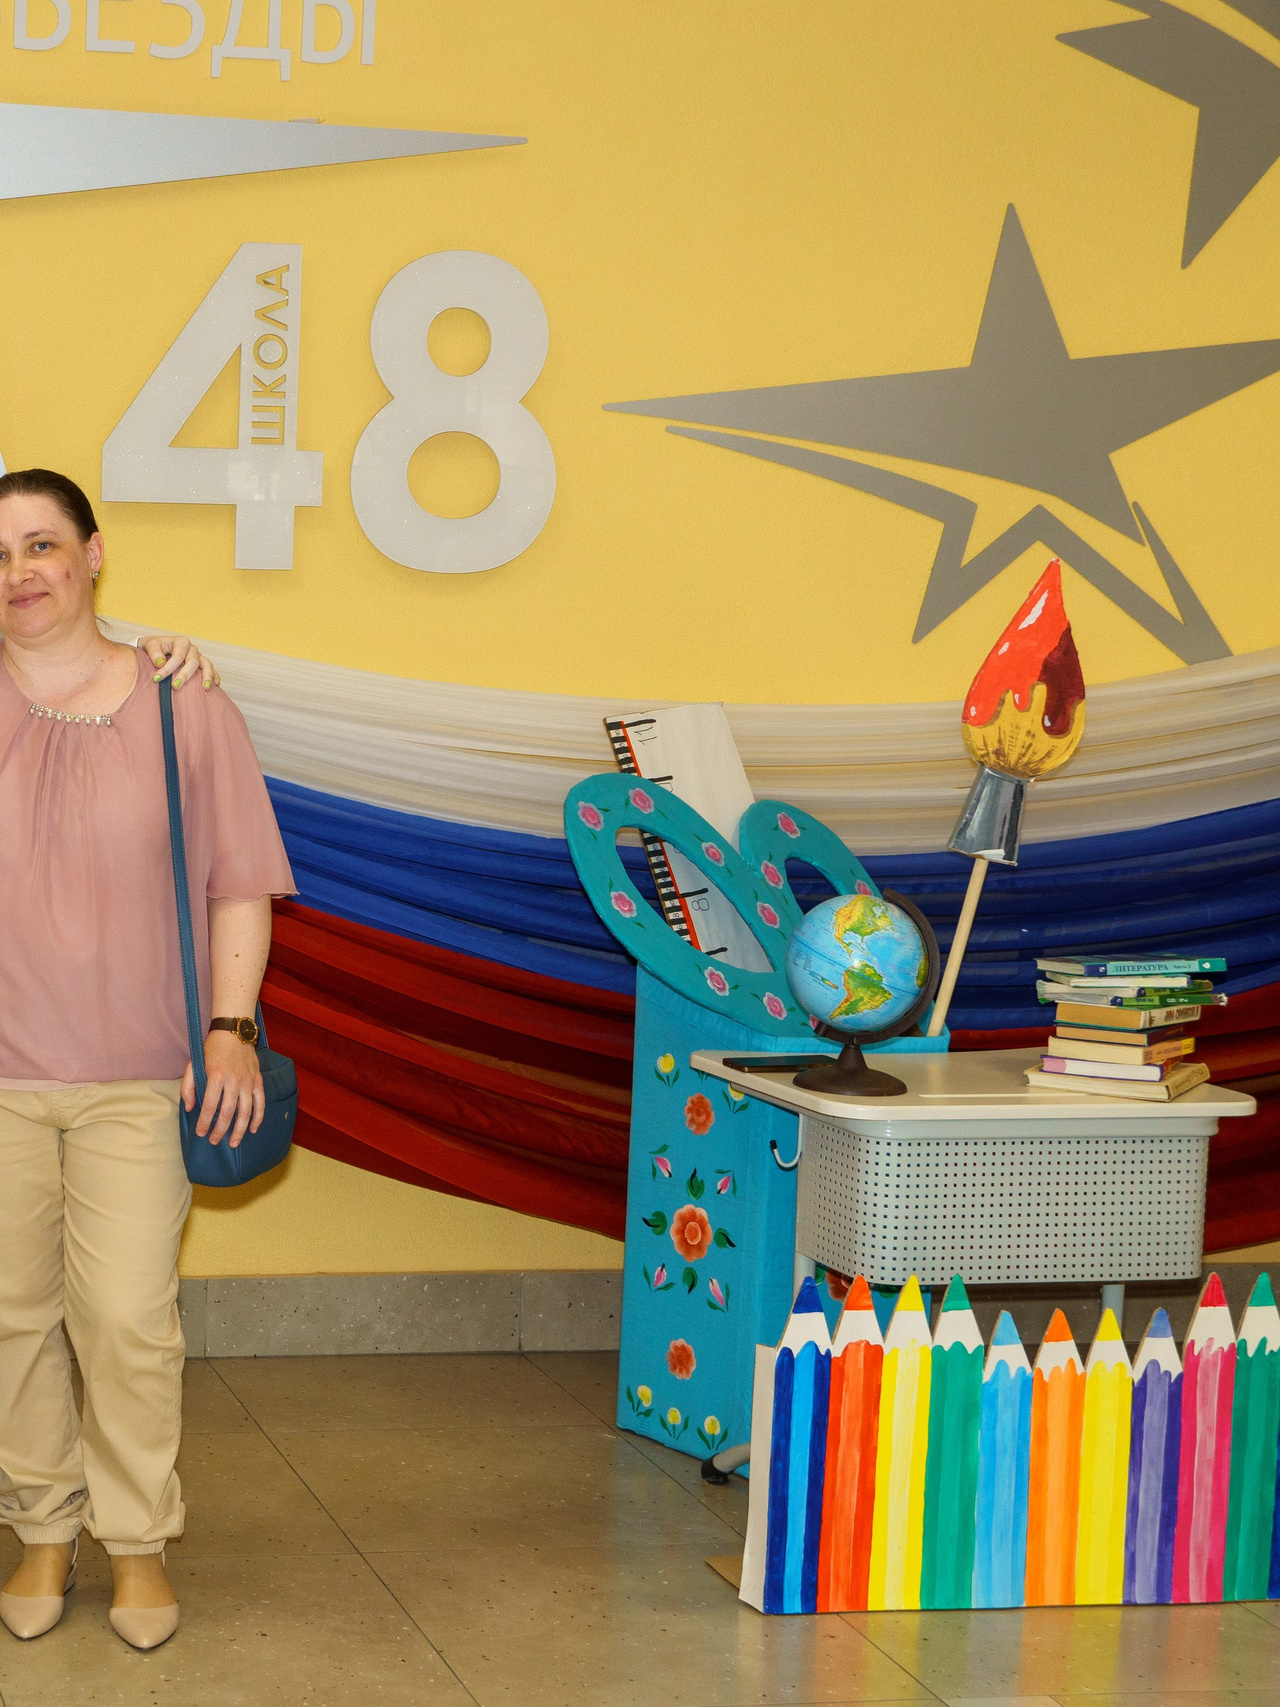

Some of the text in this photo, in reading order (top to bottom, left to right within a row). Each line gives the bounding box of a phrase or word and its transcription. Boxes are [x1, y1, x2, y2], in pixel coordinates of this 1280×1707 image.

[250, 263, 290, 446] ШКОЛА
[101, 242, 556, 575] 48
[691, 897, 710, 912] 8
[1111, 963, 1169, 974] ЛИТЕРАТУРА
